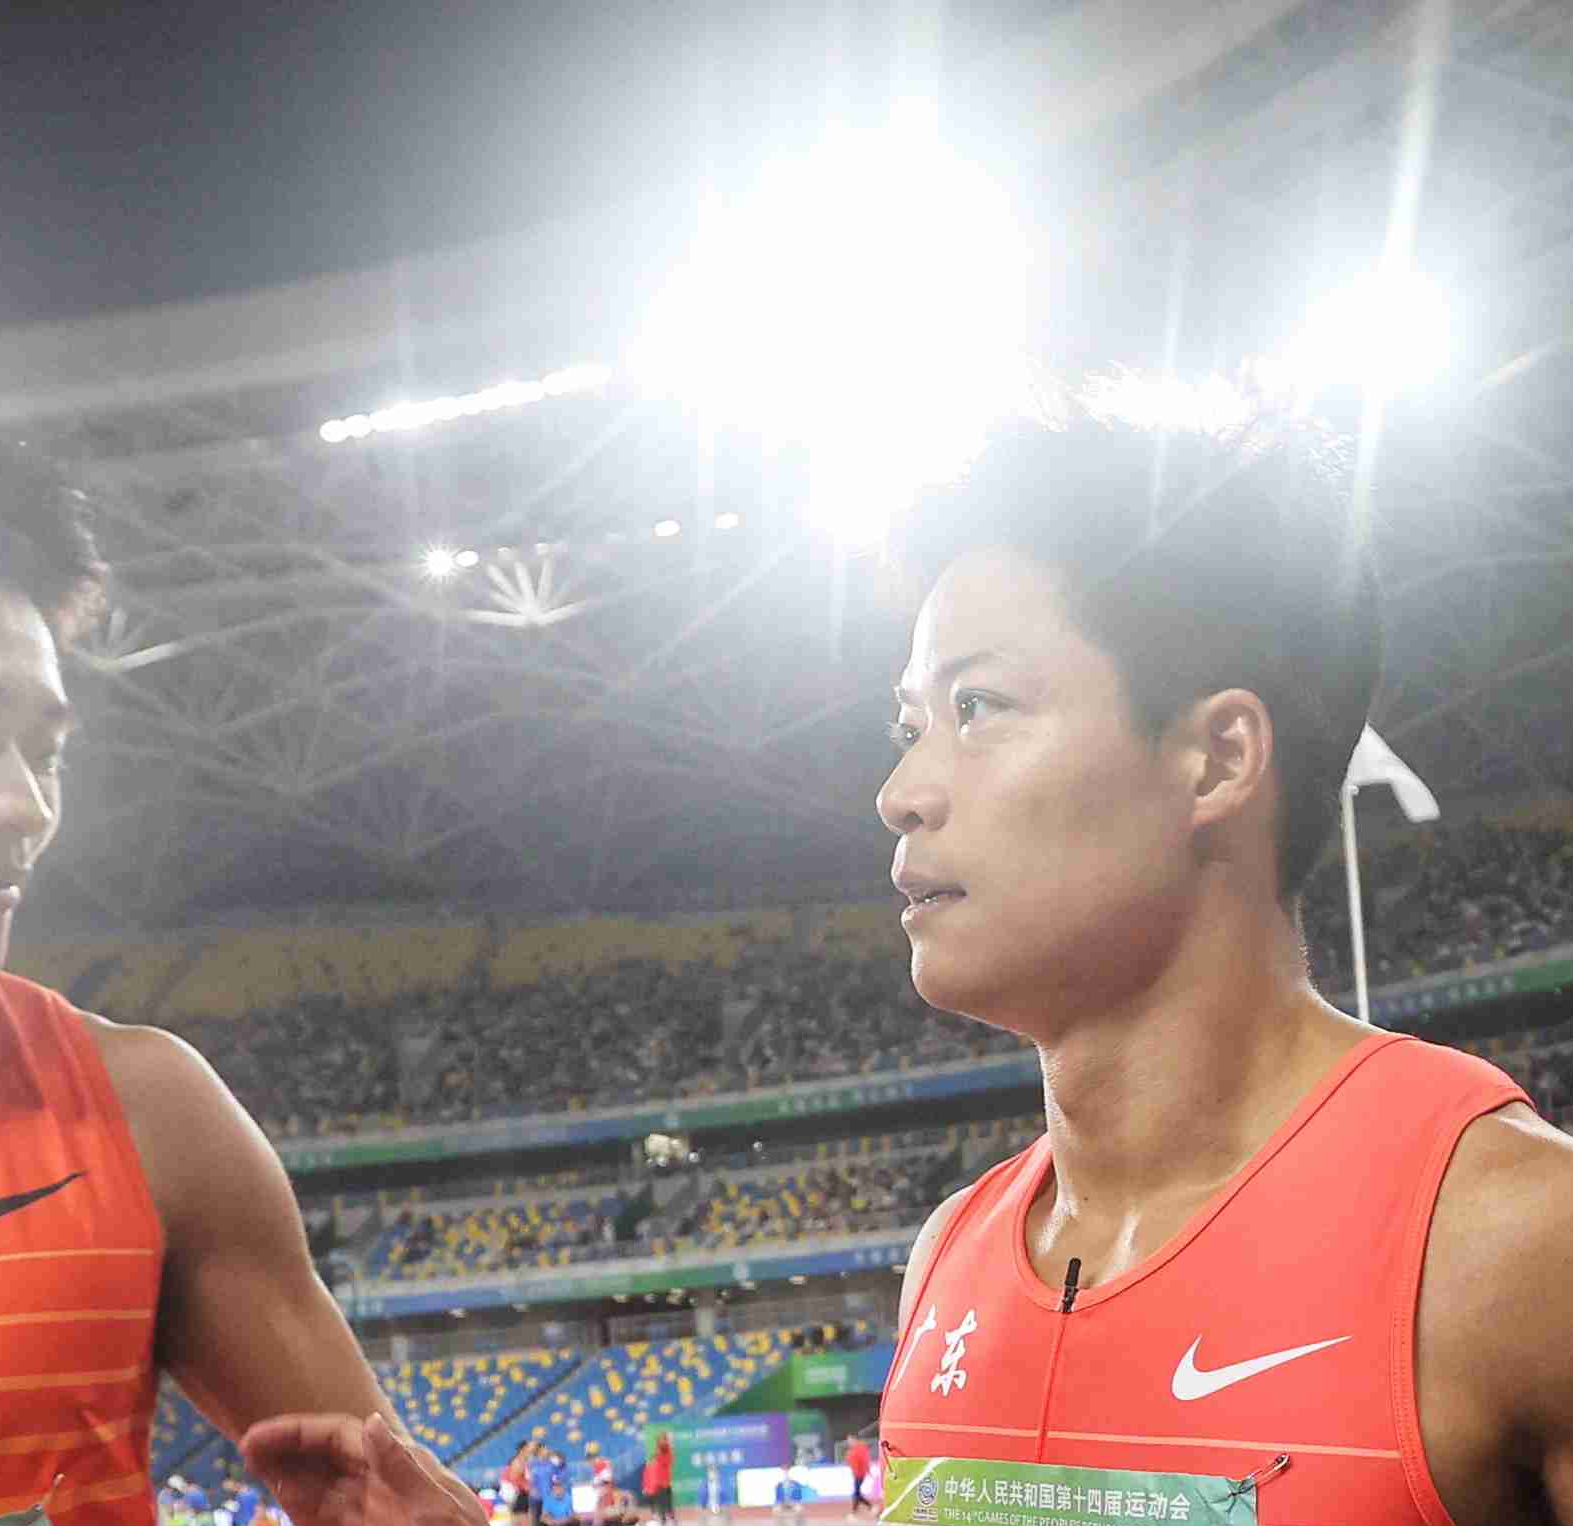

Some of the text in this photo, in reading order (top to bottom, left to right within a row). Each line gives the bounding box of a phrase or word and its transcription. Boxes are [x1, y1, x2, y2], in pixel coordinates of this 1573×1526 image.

[890, 1303, 978, 1398] 广东
[943, 1476, 1192, 1521] 中华人民共和国第十四届运动会
